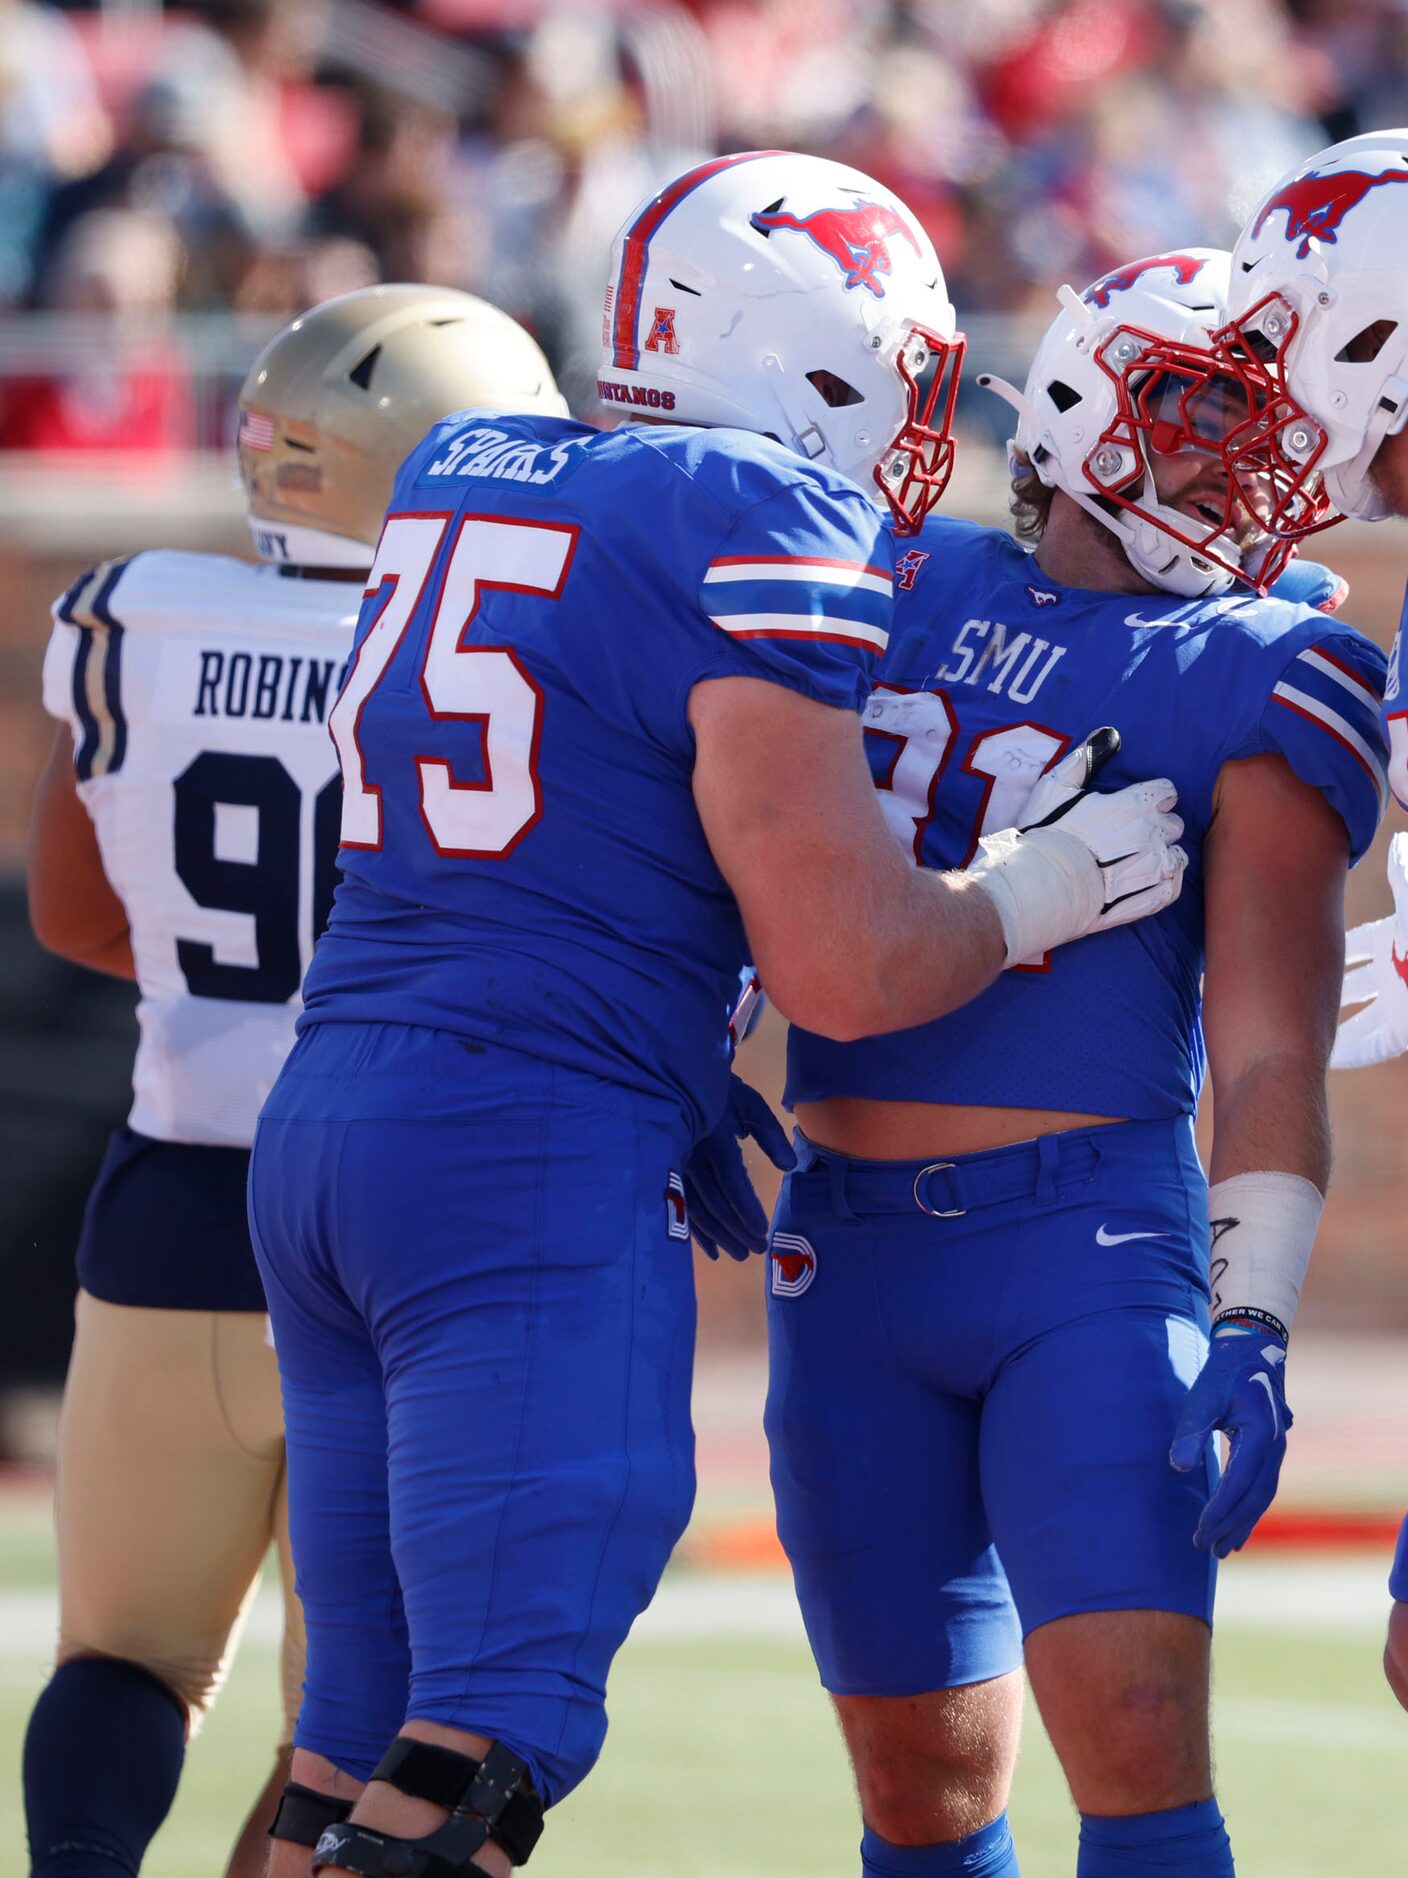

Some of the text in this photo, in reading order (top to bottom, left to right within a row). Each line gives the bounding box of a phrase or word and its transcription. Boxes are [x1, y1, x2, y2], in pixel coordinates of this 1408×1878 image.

[329, 510, 582, 860] 75
[935, 618, 1067, 704] SMU
[1248, 1309, 1264, 1319] WE
[1265, 1315, 1282, 1330] CAN
